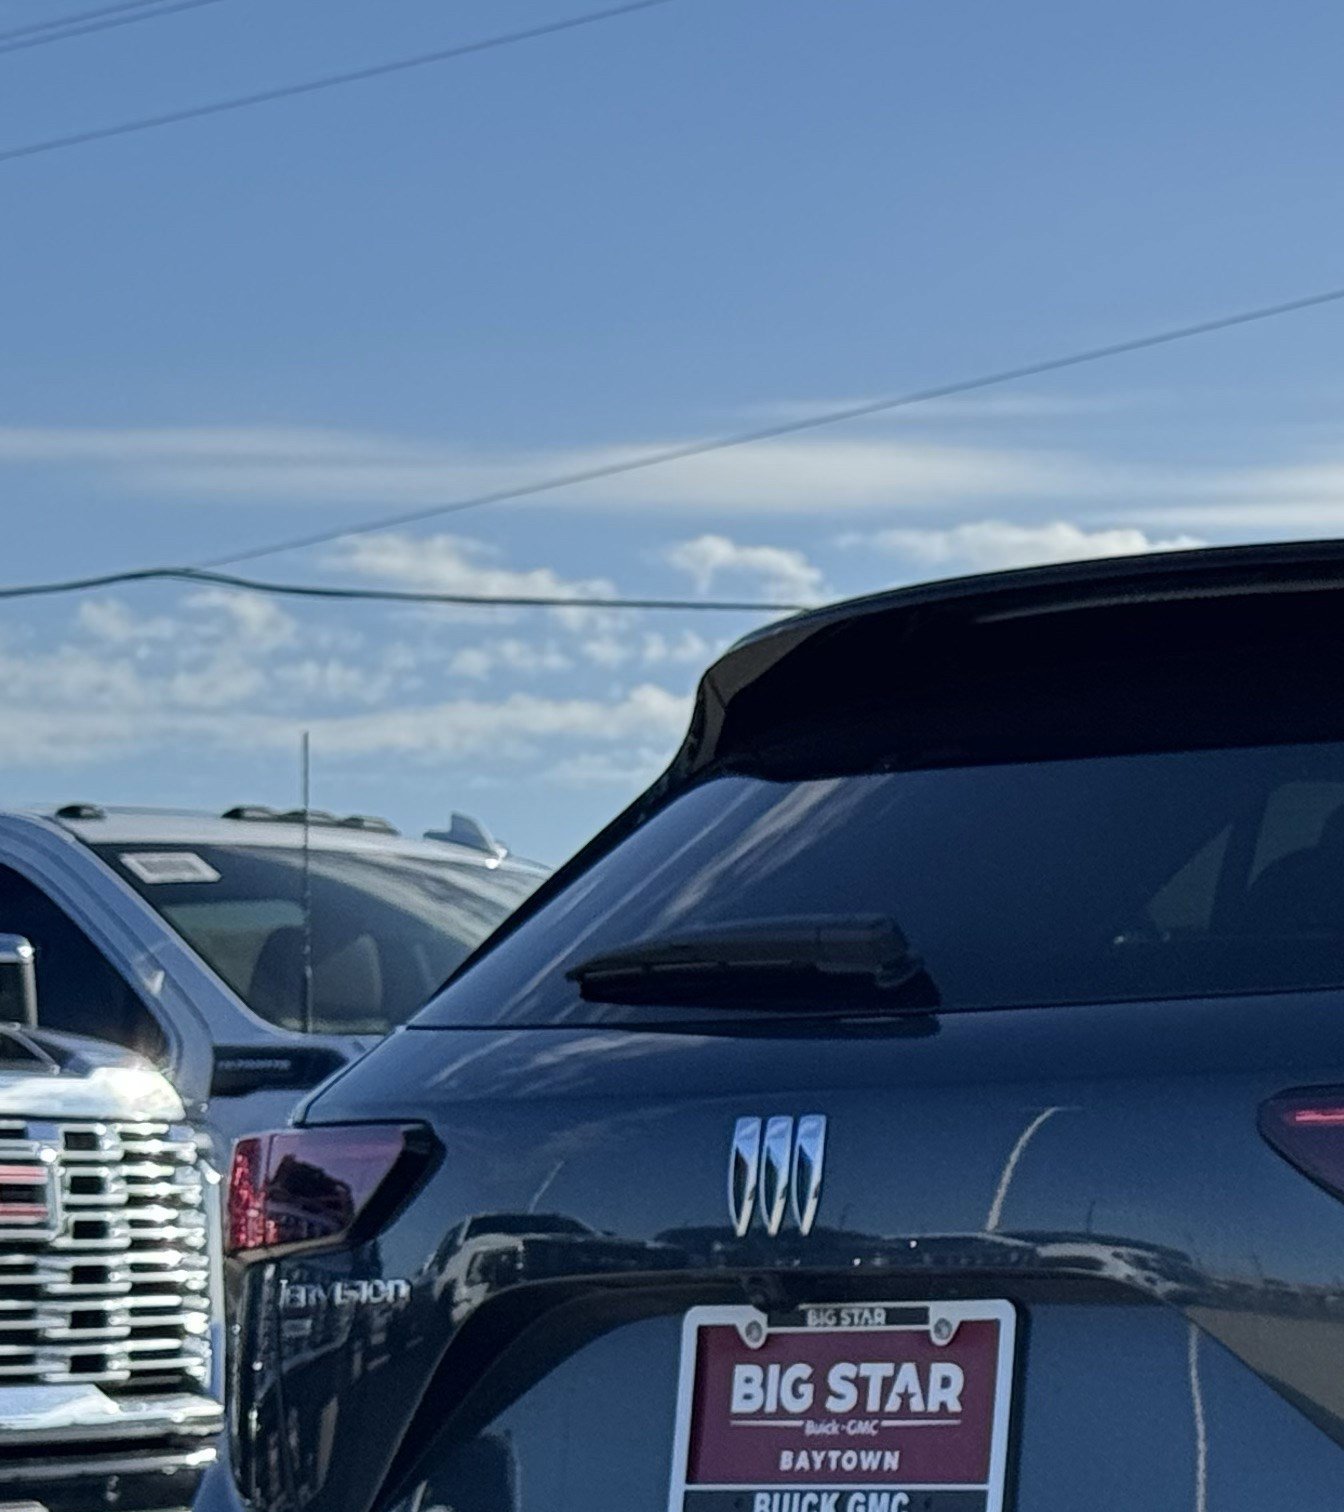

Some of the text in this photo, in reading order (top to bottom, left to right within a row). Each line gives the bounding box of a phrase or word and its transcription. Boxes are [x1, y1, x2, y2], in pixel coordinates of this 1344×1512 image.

[807, 1308, 886, 1327] BIG STAR
[730, 1362, 965, 1414] BIG STAR
[779, 1450, 901, 1471] BAYTOWN
